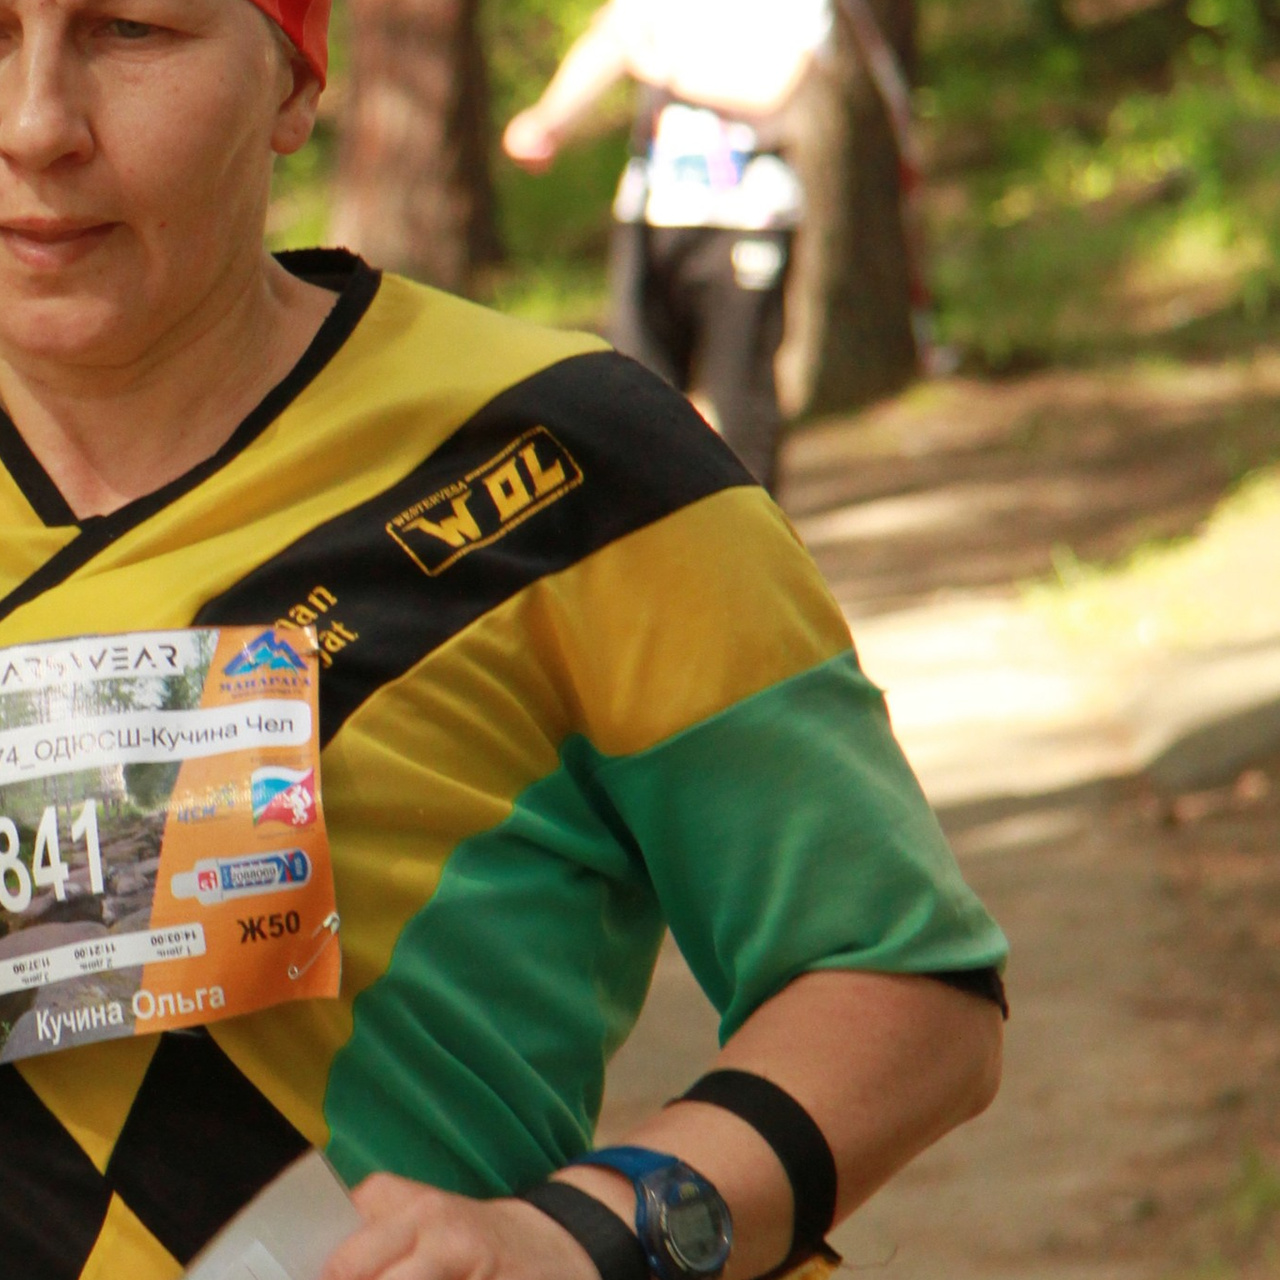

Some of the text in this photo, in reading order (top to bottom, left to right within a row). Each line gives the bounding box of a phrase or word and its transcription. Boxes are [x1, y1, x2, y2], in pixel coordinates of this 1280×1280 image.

[246, 715, 295, 734] Чел
[237, 910, 301, 945] Ж50
[36, 985, 226, 1046] Кучина Ольга
